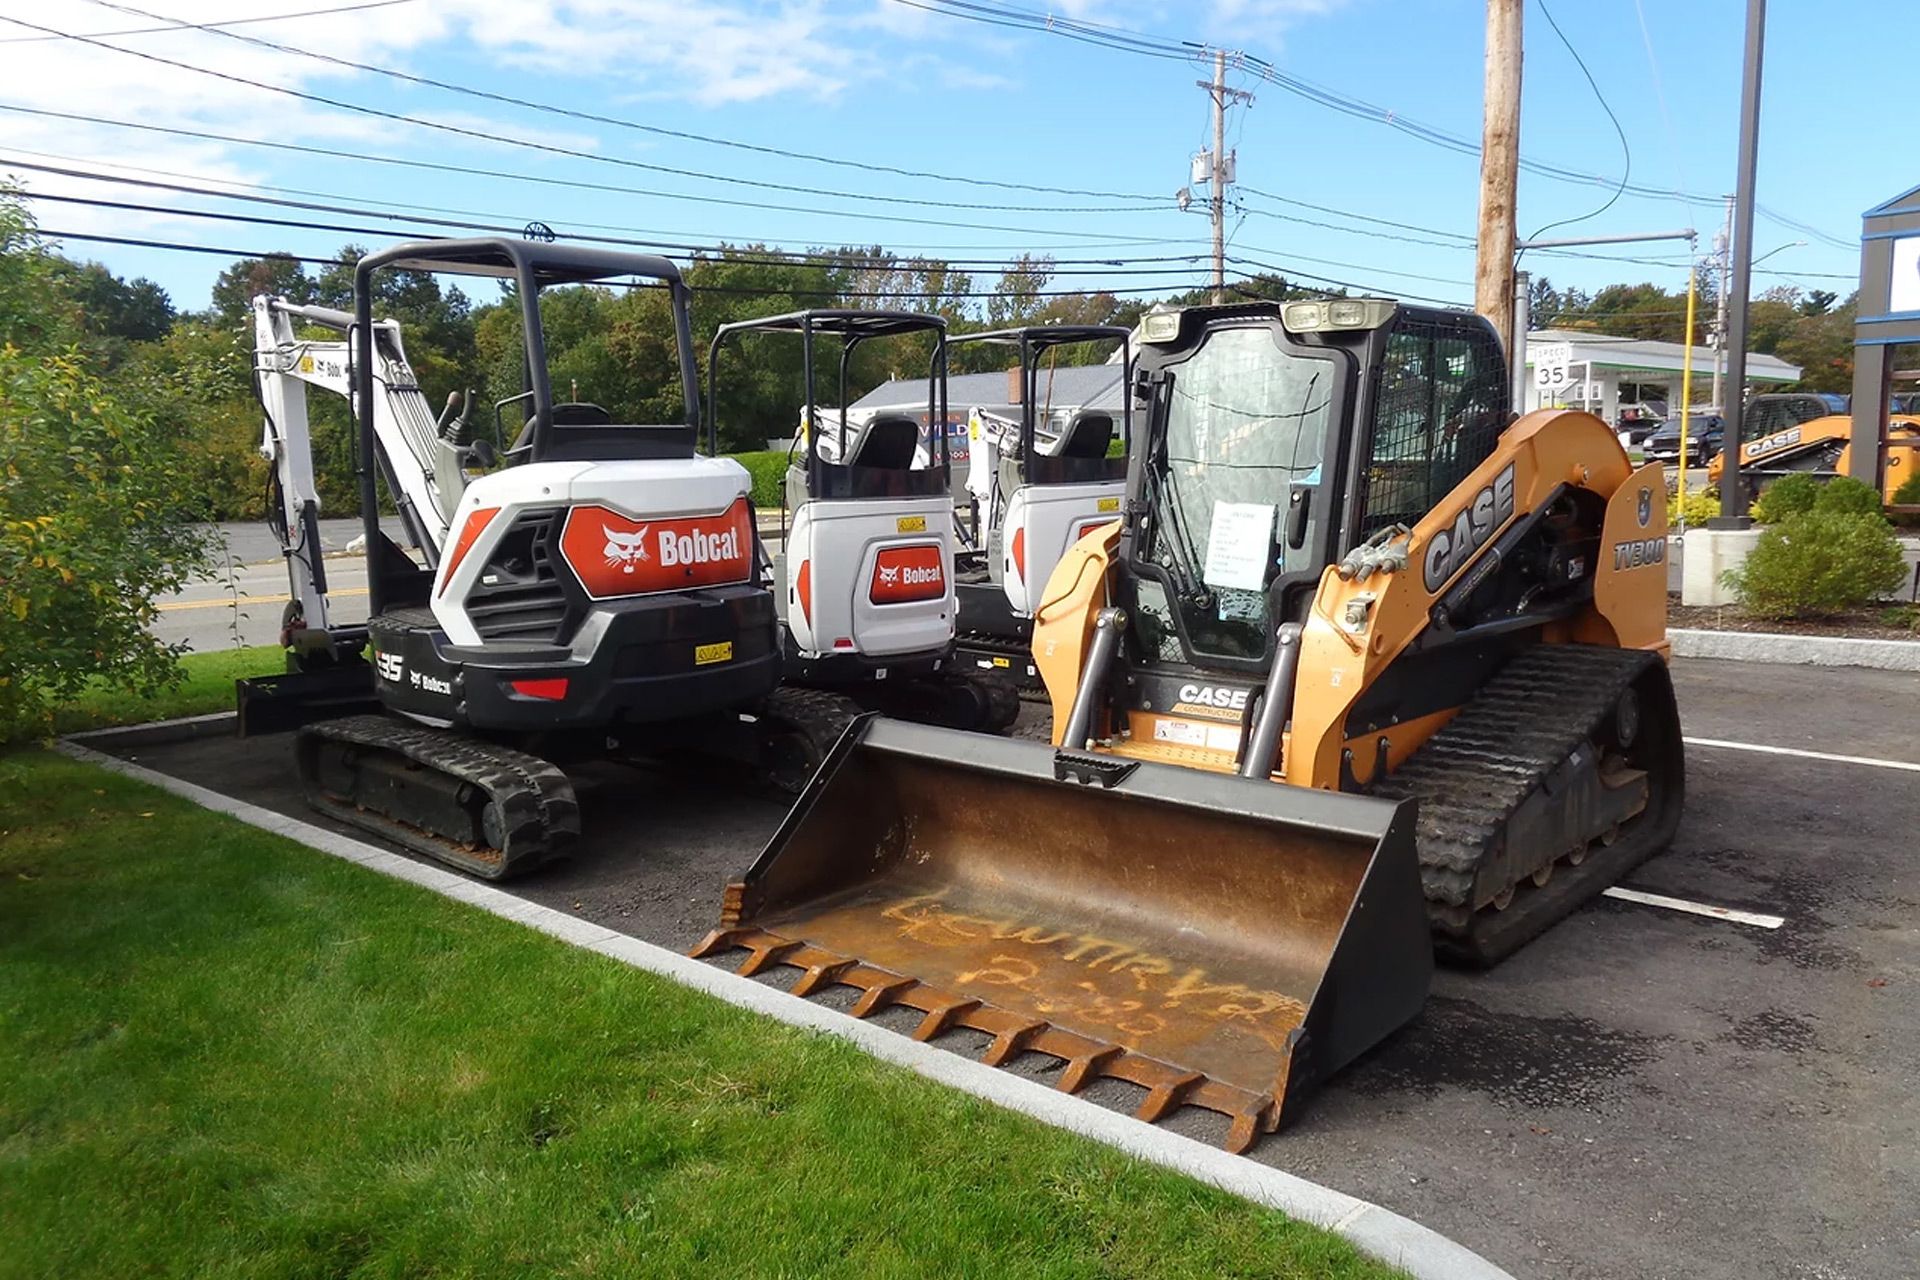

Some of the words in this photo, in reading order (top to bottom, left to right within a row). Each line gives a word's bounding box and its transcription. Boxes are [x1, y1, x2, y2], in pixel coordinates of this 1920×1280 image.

[1539, 367, 1564, 385] 35
[1747, 429, 1800, 456] CASE
[1423, 462, 1515, 594] CASE
[658, 526, 739, 567] Bobcat
[1613, 537, 1666, 572] TV380
[903, 565, 941, 584] Bobcat
[1179, 684, 1250, 709] CASE
[1183, 705, 1240, 719] CONSTRUCTION
